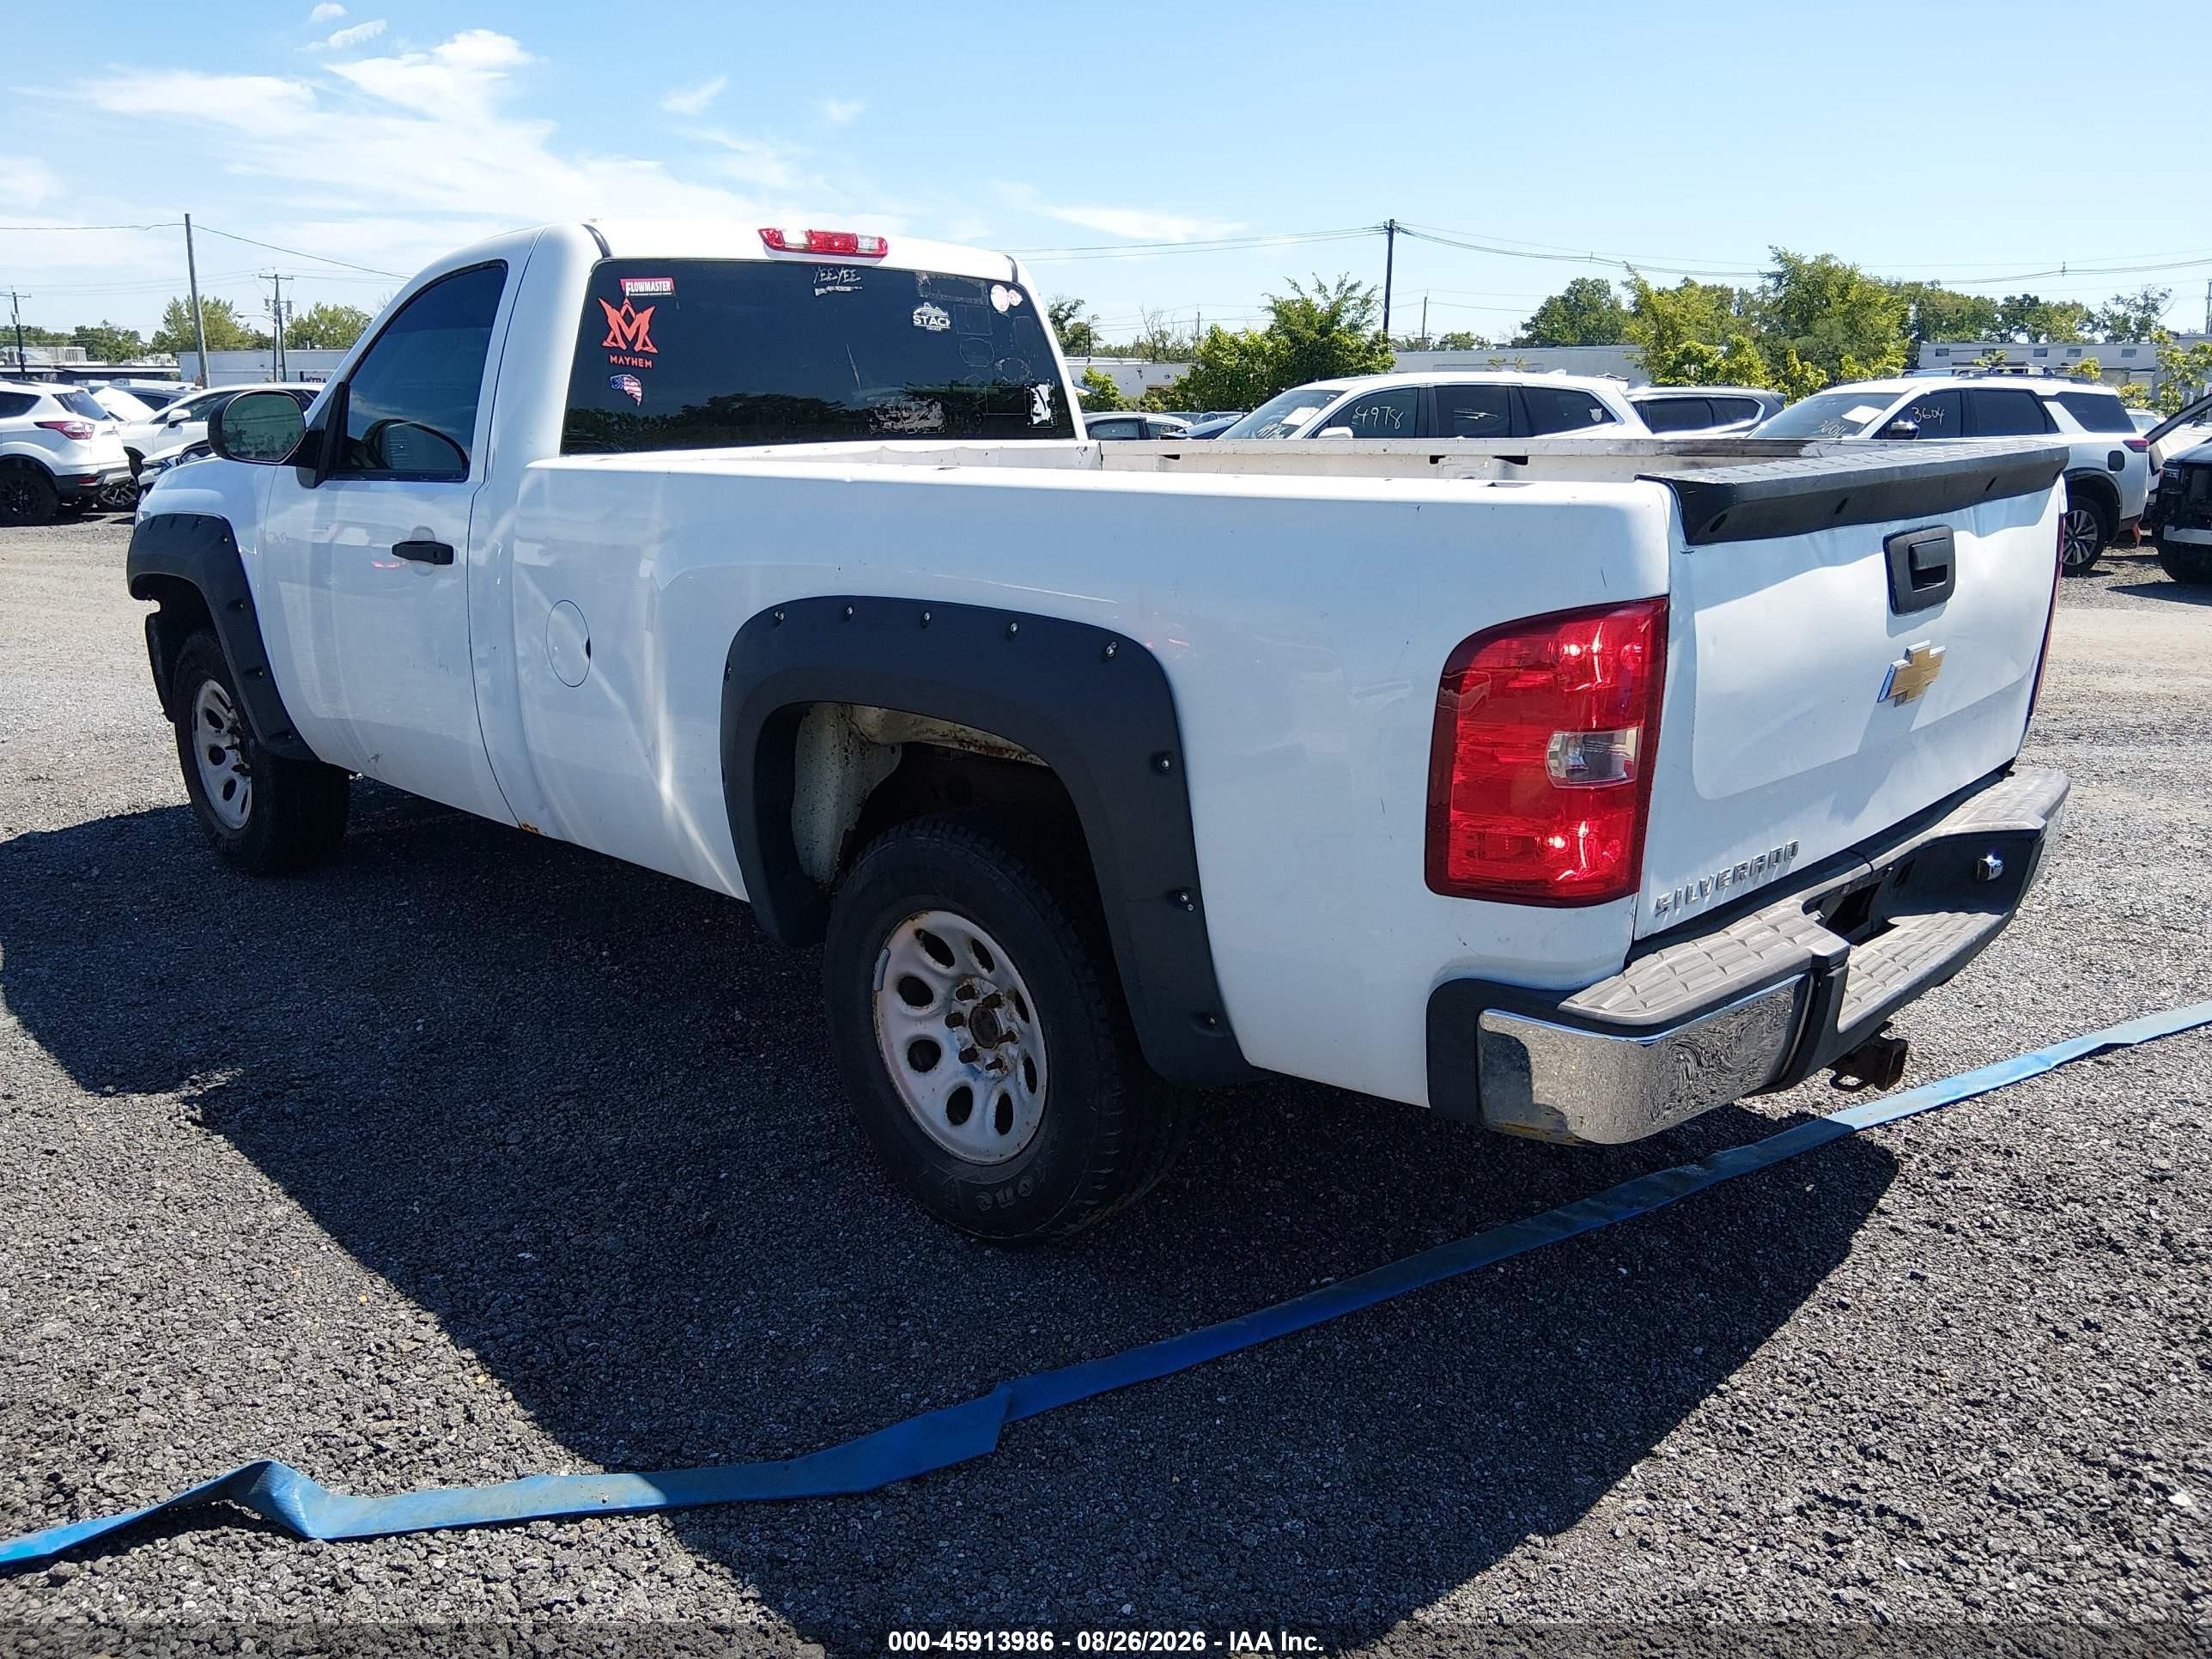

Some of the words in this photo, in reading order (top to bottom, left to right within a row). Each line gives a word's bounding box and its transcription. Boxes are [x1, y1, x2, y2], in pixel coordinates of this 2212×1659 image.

[625, 280, 672, 297] FLOWMASTER
[609, 354, 653, 369] MAYHEM
[1354, 405, 1405, 430] 4978
[1911, 406, 1945, 427] 3604
[1655, 839, 1800, 917] SILVERADO
